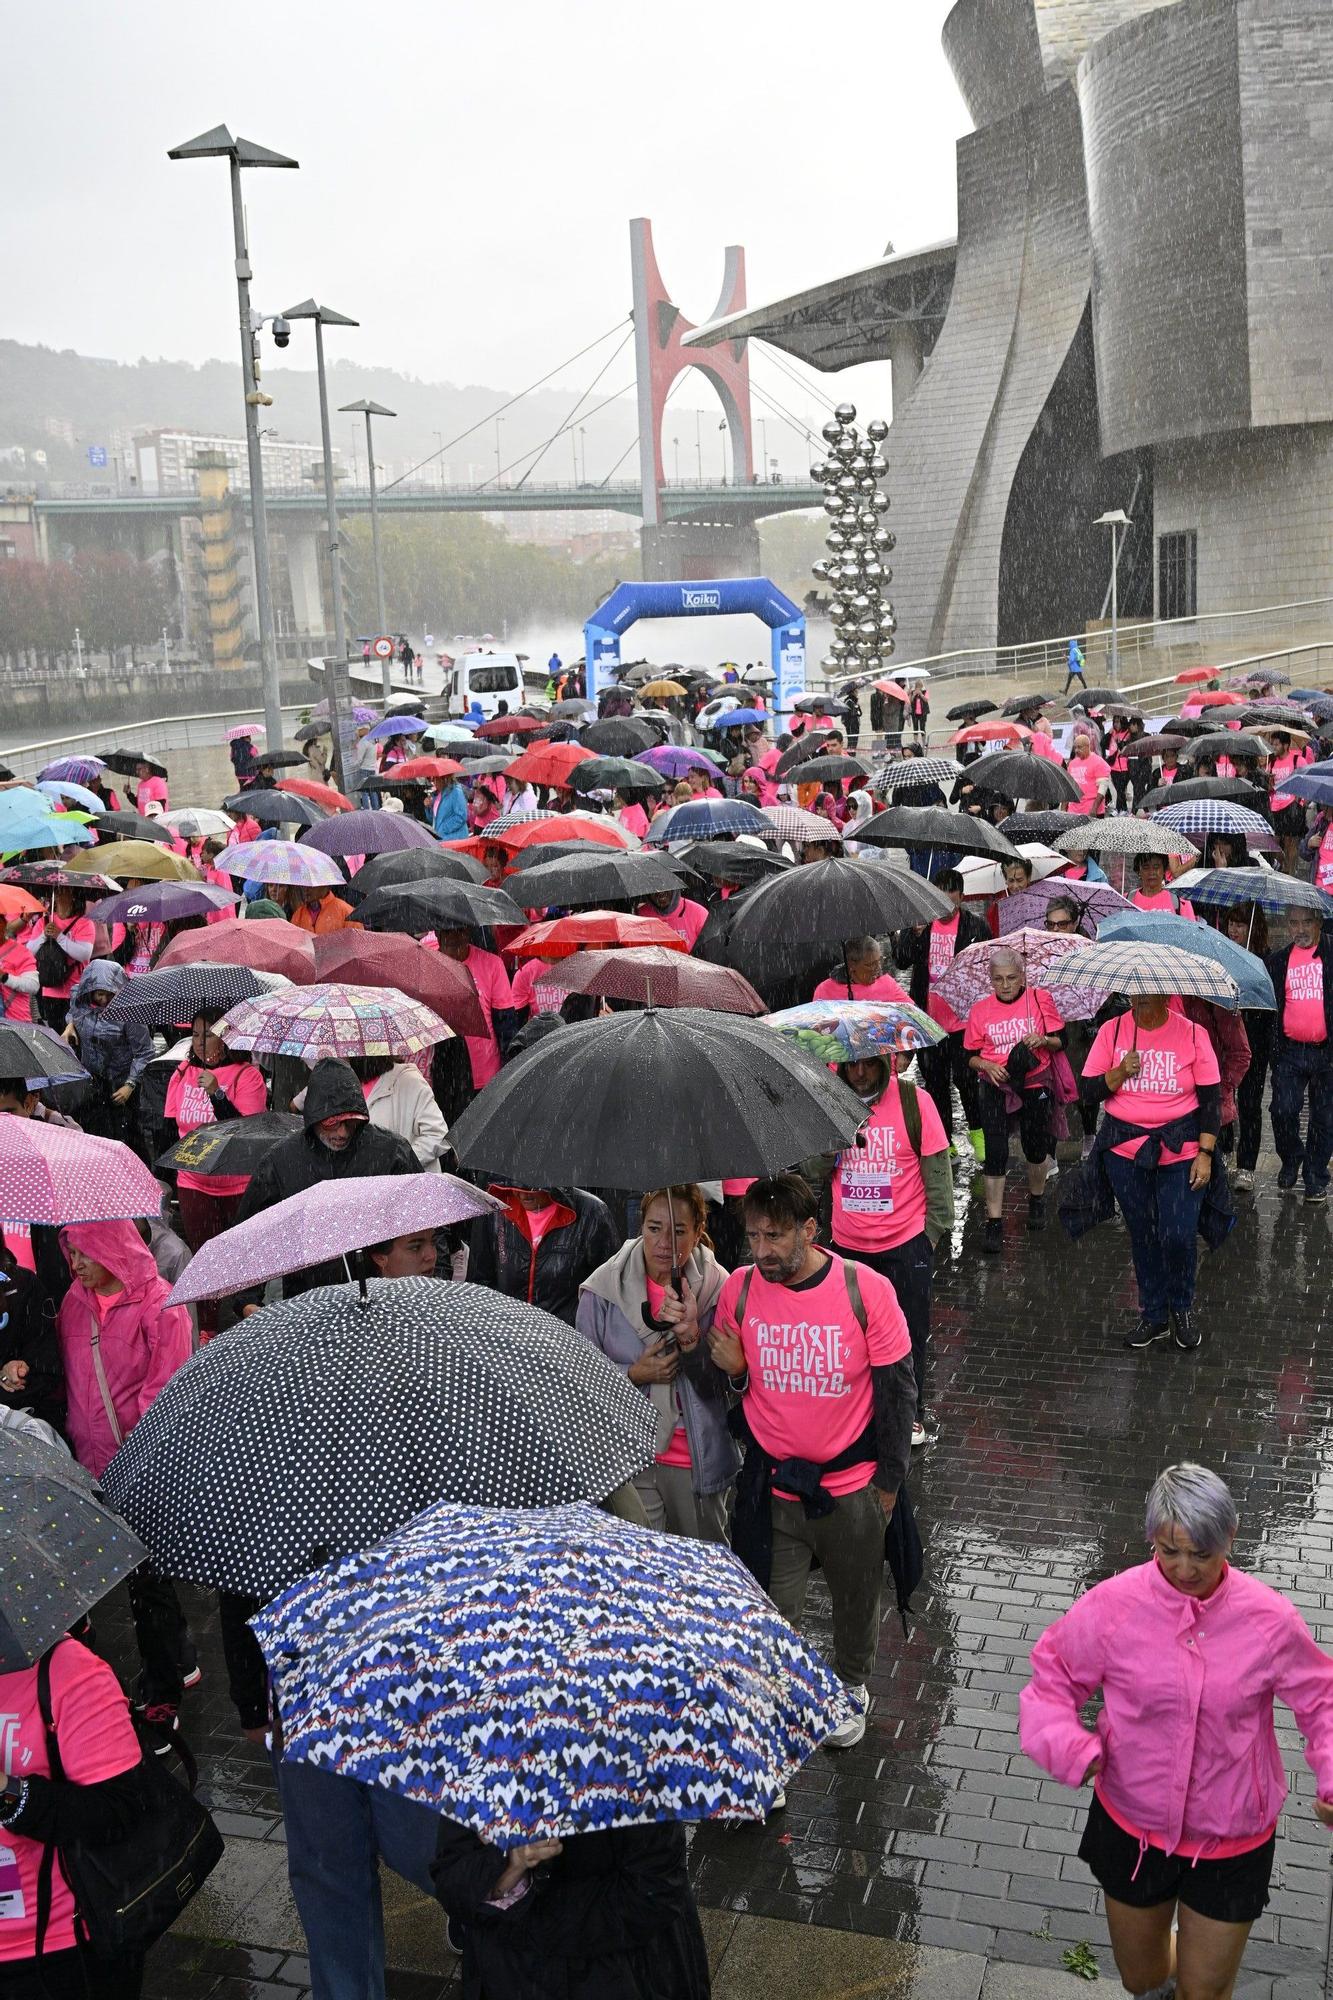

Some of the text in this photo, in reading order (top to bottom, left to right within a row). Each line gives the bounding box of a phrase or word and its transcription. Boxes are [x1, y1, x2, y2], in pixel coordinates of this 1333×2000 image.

[686, 593, 717, 606] Kaiku
[179, 1108, 217, 1123] AVANZ
[849, 1186, 881, 1199] 2025
[763, 1369, 850, 1398] AVANZA
